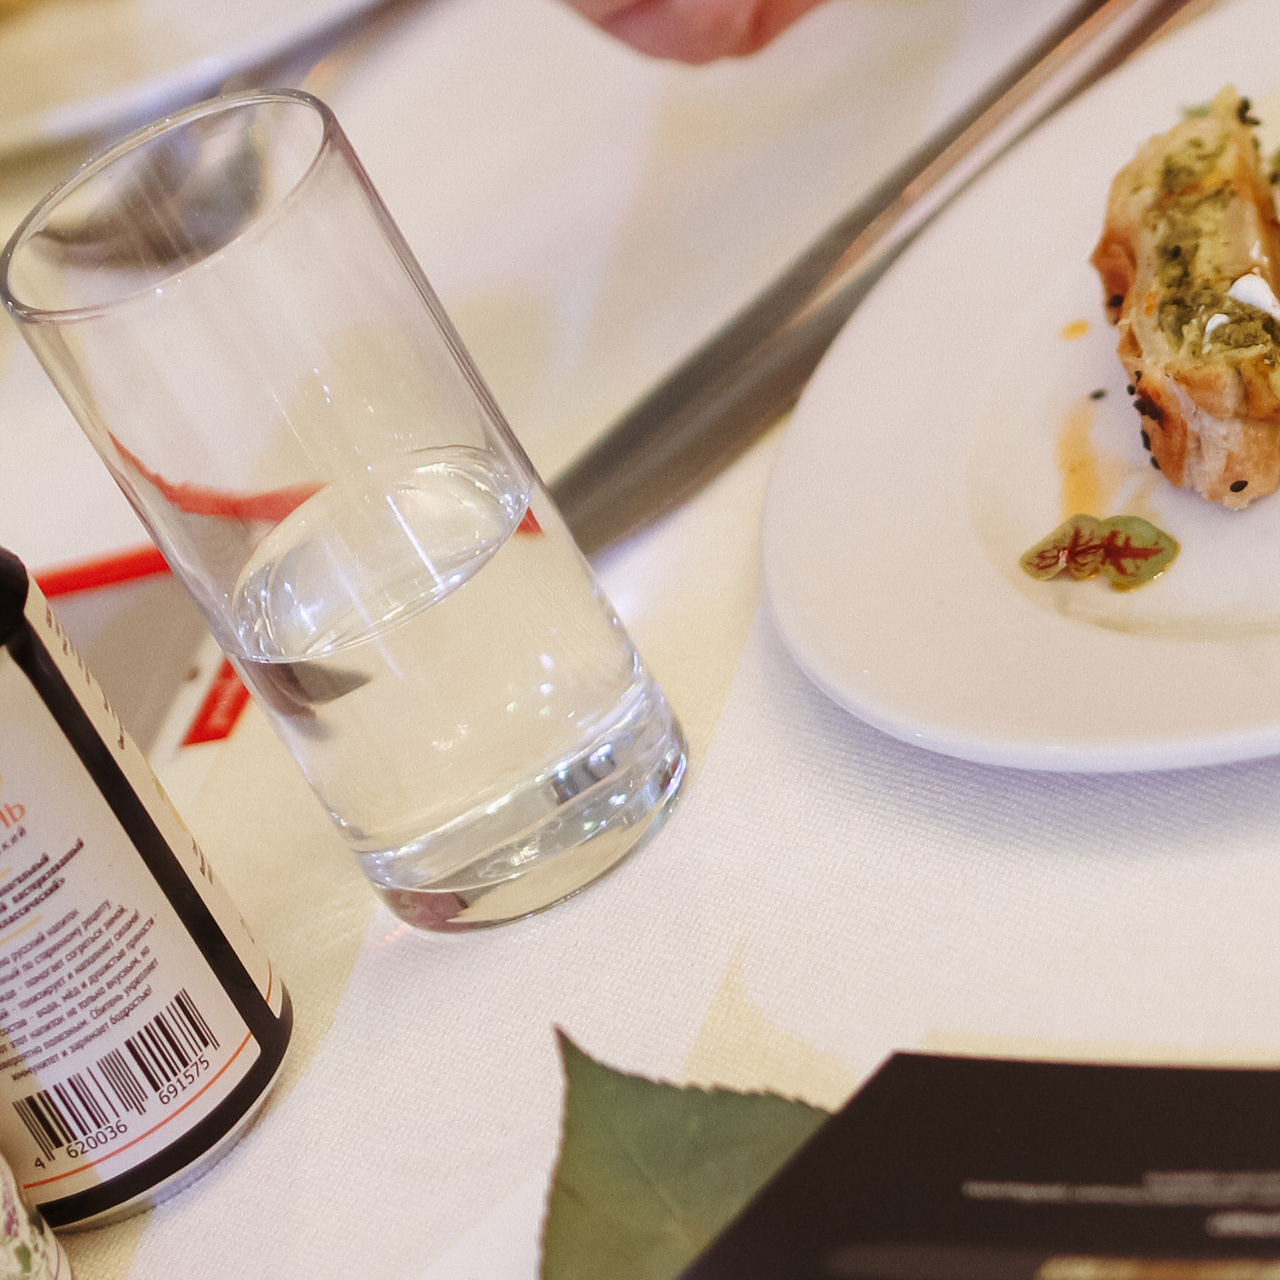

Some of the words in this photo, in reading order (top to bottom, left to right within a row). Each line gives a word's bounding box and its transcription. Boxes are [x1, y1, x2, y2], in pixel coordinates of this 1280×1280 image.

[11, 931, 46, 961] русский
[47, 908, 79, 937] напиток
[22, 961, 34, 971] по
[34, 926, 82, 963] старинному
[25, 959, 64, 988] помогает
[65, 927, 104, 962] согреться
[62, 986, 81, 1002] мёд
[88, 948, 126, 985] душистые
[126, 917, 154, 950] пряности
[18, 976, 66, 1009] тонизирует
[74, 938, 114, 974] наполняет
[29, 1015, 64, 1039] напиток
[66, 1007, 77, 1018] не
[78, 986, 106, 1010] только
[140, 945, 150, 958] но
[90, 994, 123, 1020] Сбитень
[123, 958, 158, 997] укрепляет
[11, 1053, 60, 1081] иммунитет
[69, 1022, 109, 1053] заряжает
[109, 984, 153, 1025] бодростью!
[34, 1157, 46, 1170] 4
[66, 1119, 128, 1159] 620036
[158, 1053, 210, 1105] 691575
